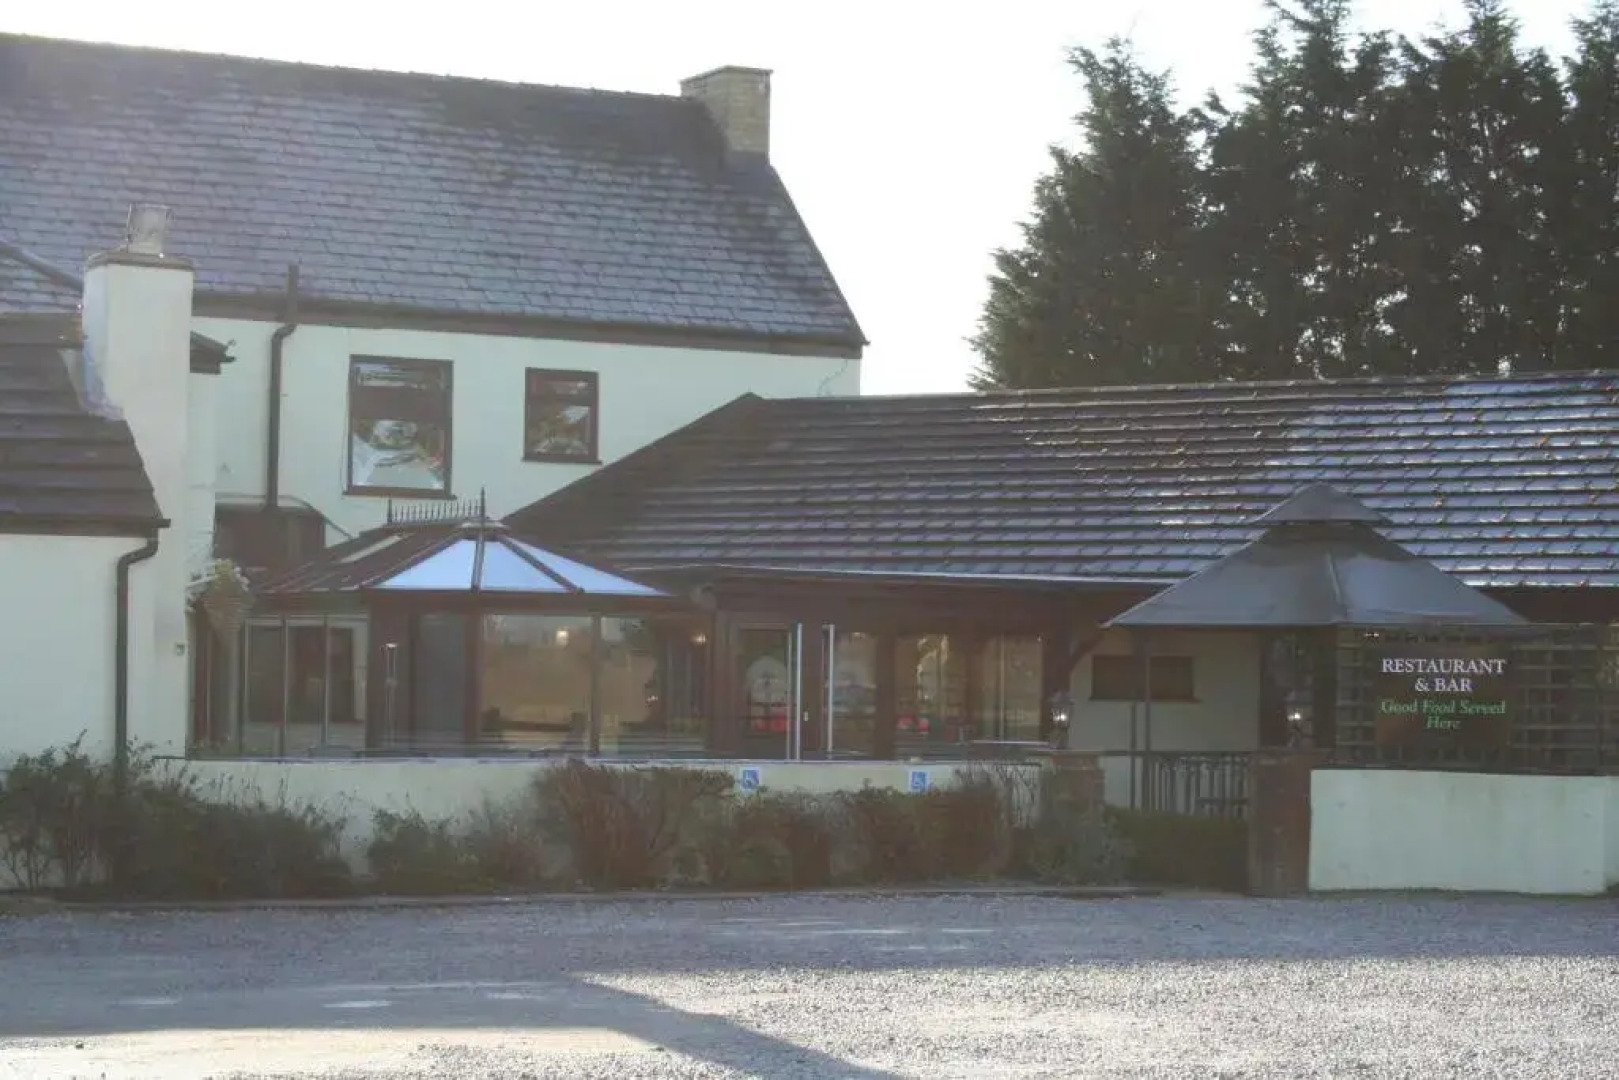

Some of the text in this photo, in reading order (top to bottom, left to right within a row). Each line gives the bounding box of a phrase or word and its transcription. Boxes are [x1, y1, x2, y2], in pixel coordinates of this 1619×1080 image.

[1381, 658, 1506, 673] RESTAURANT
[1415, 678, 1473, 692] & BAR
[1381, 699, 1506, 714] Good Food Served
[1425, 715, 1461, 730] Here
